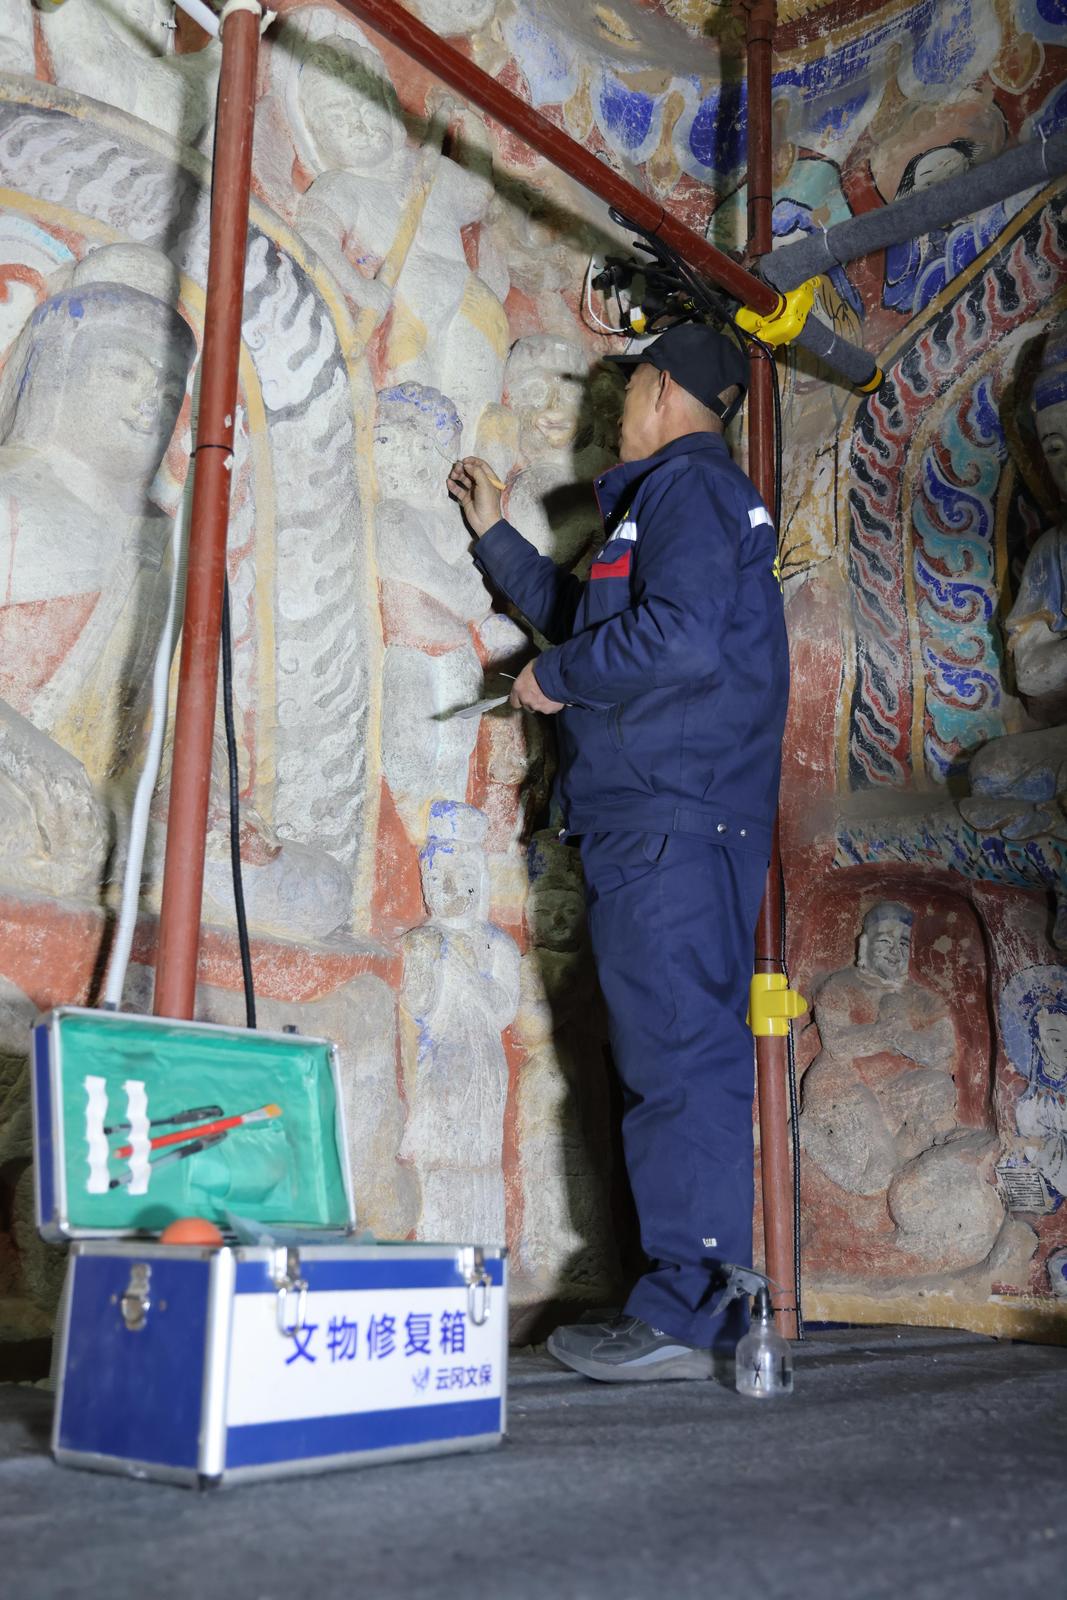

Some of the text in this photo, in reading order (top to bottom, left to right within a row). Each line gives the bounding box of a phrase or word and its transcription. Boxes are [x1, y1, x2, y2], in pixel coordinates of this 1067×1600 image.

[285, 1309, 466, 1365] 文物修复箱
